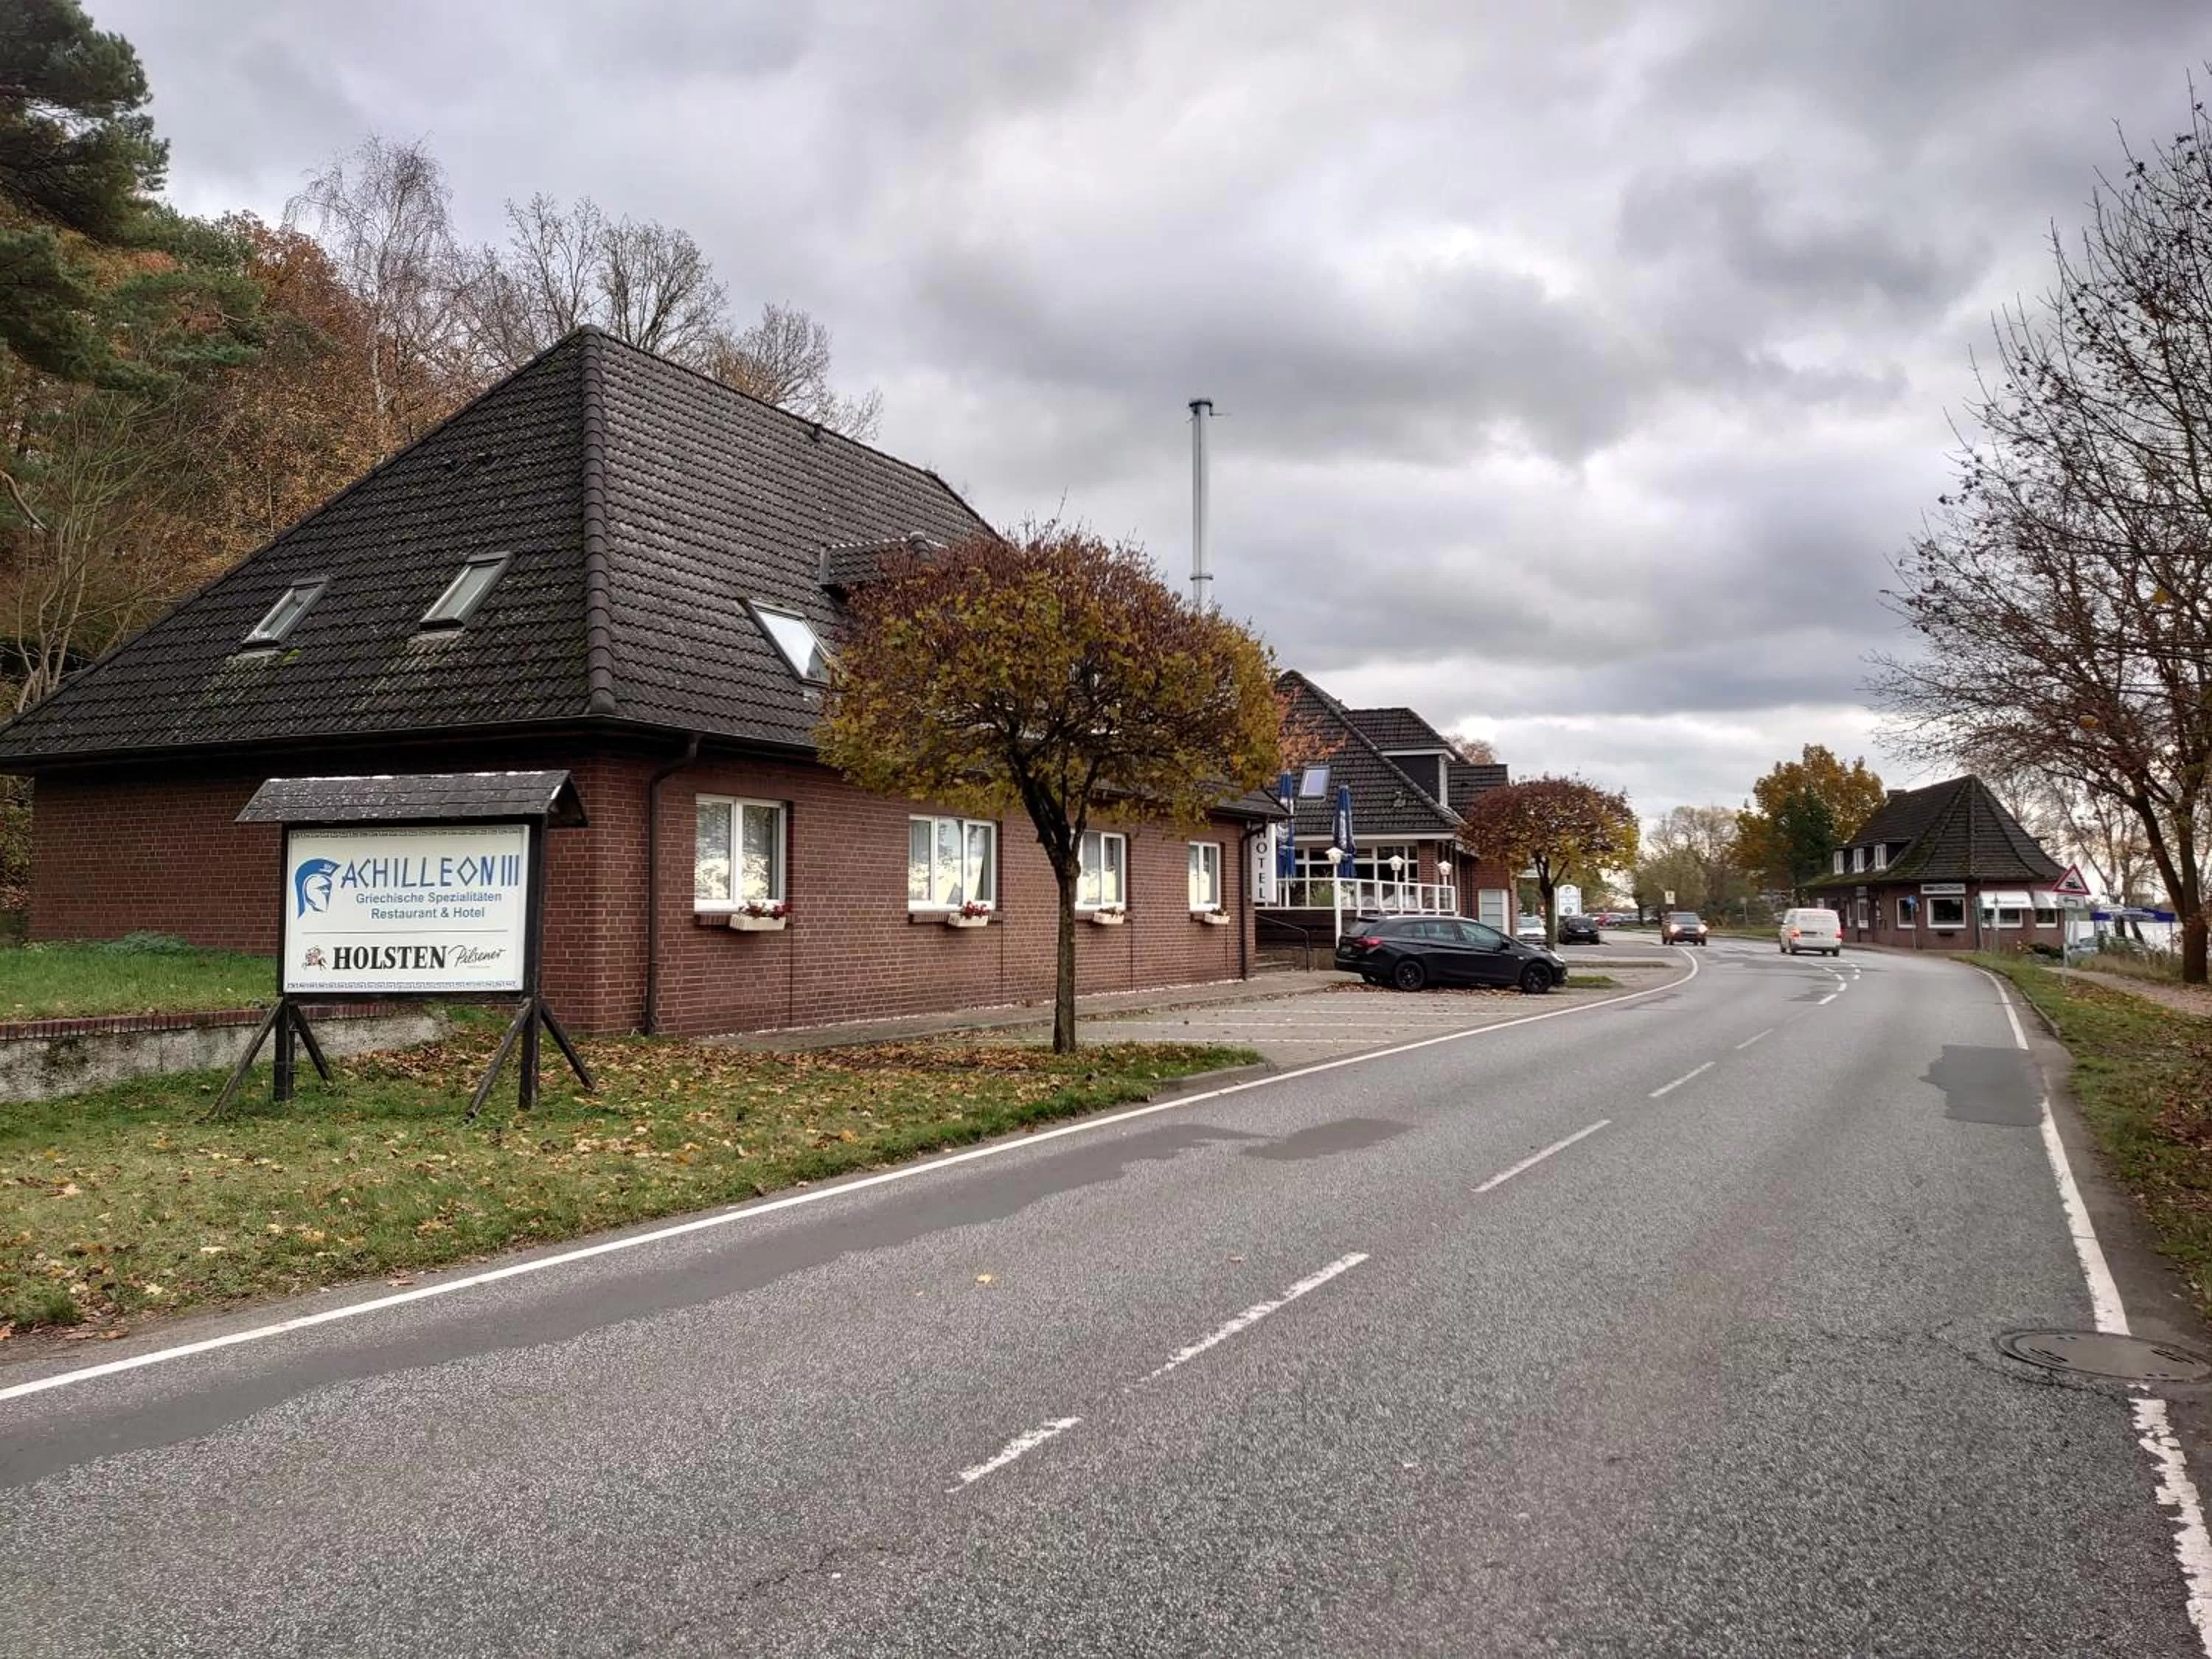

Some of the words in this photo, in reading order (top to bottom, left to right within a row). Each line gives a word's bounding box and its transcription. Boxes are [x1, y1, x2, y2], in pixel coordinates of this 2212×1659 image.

[341, 856, 495, 888] ACHILLEON
[501, 855, 519, 887] III
[356, 894, 424, 904] Griechische
[428, 892, 502, 905] Spezialitäten
[371, 908, 437, 919] Restaurant
[440, 908, 449, 918] &
[453, 907, 484, 919] Hotel
[332, 946, 447, 970] HOLSTEN
[448, 945, 506, 967] Pilsener
